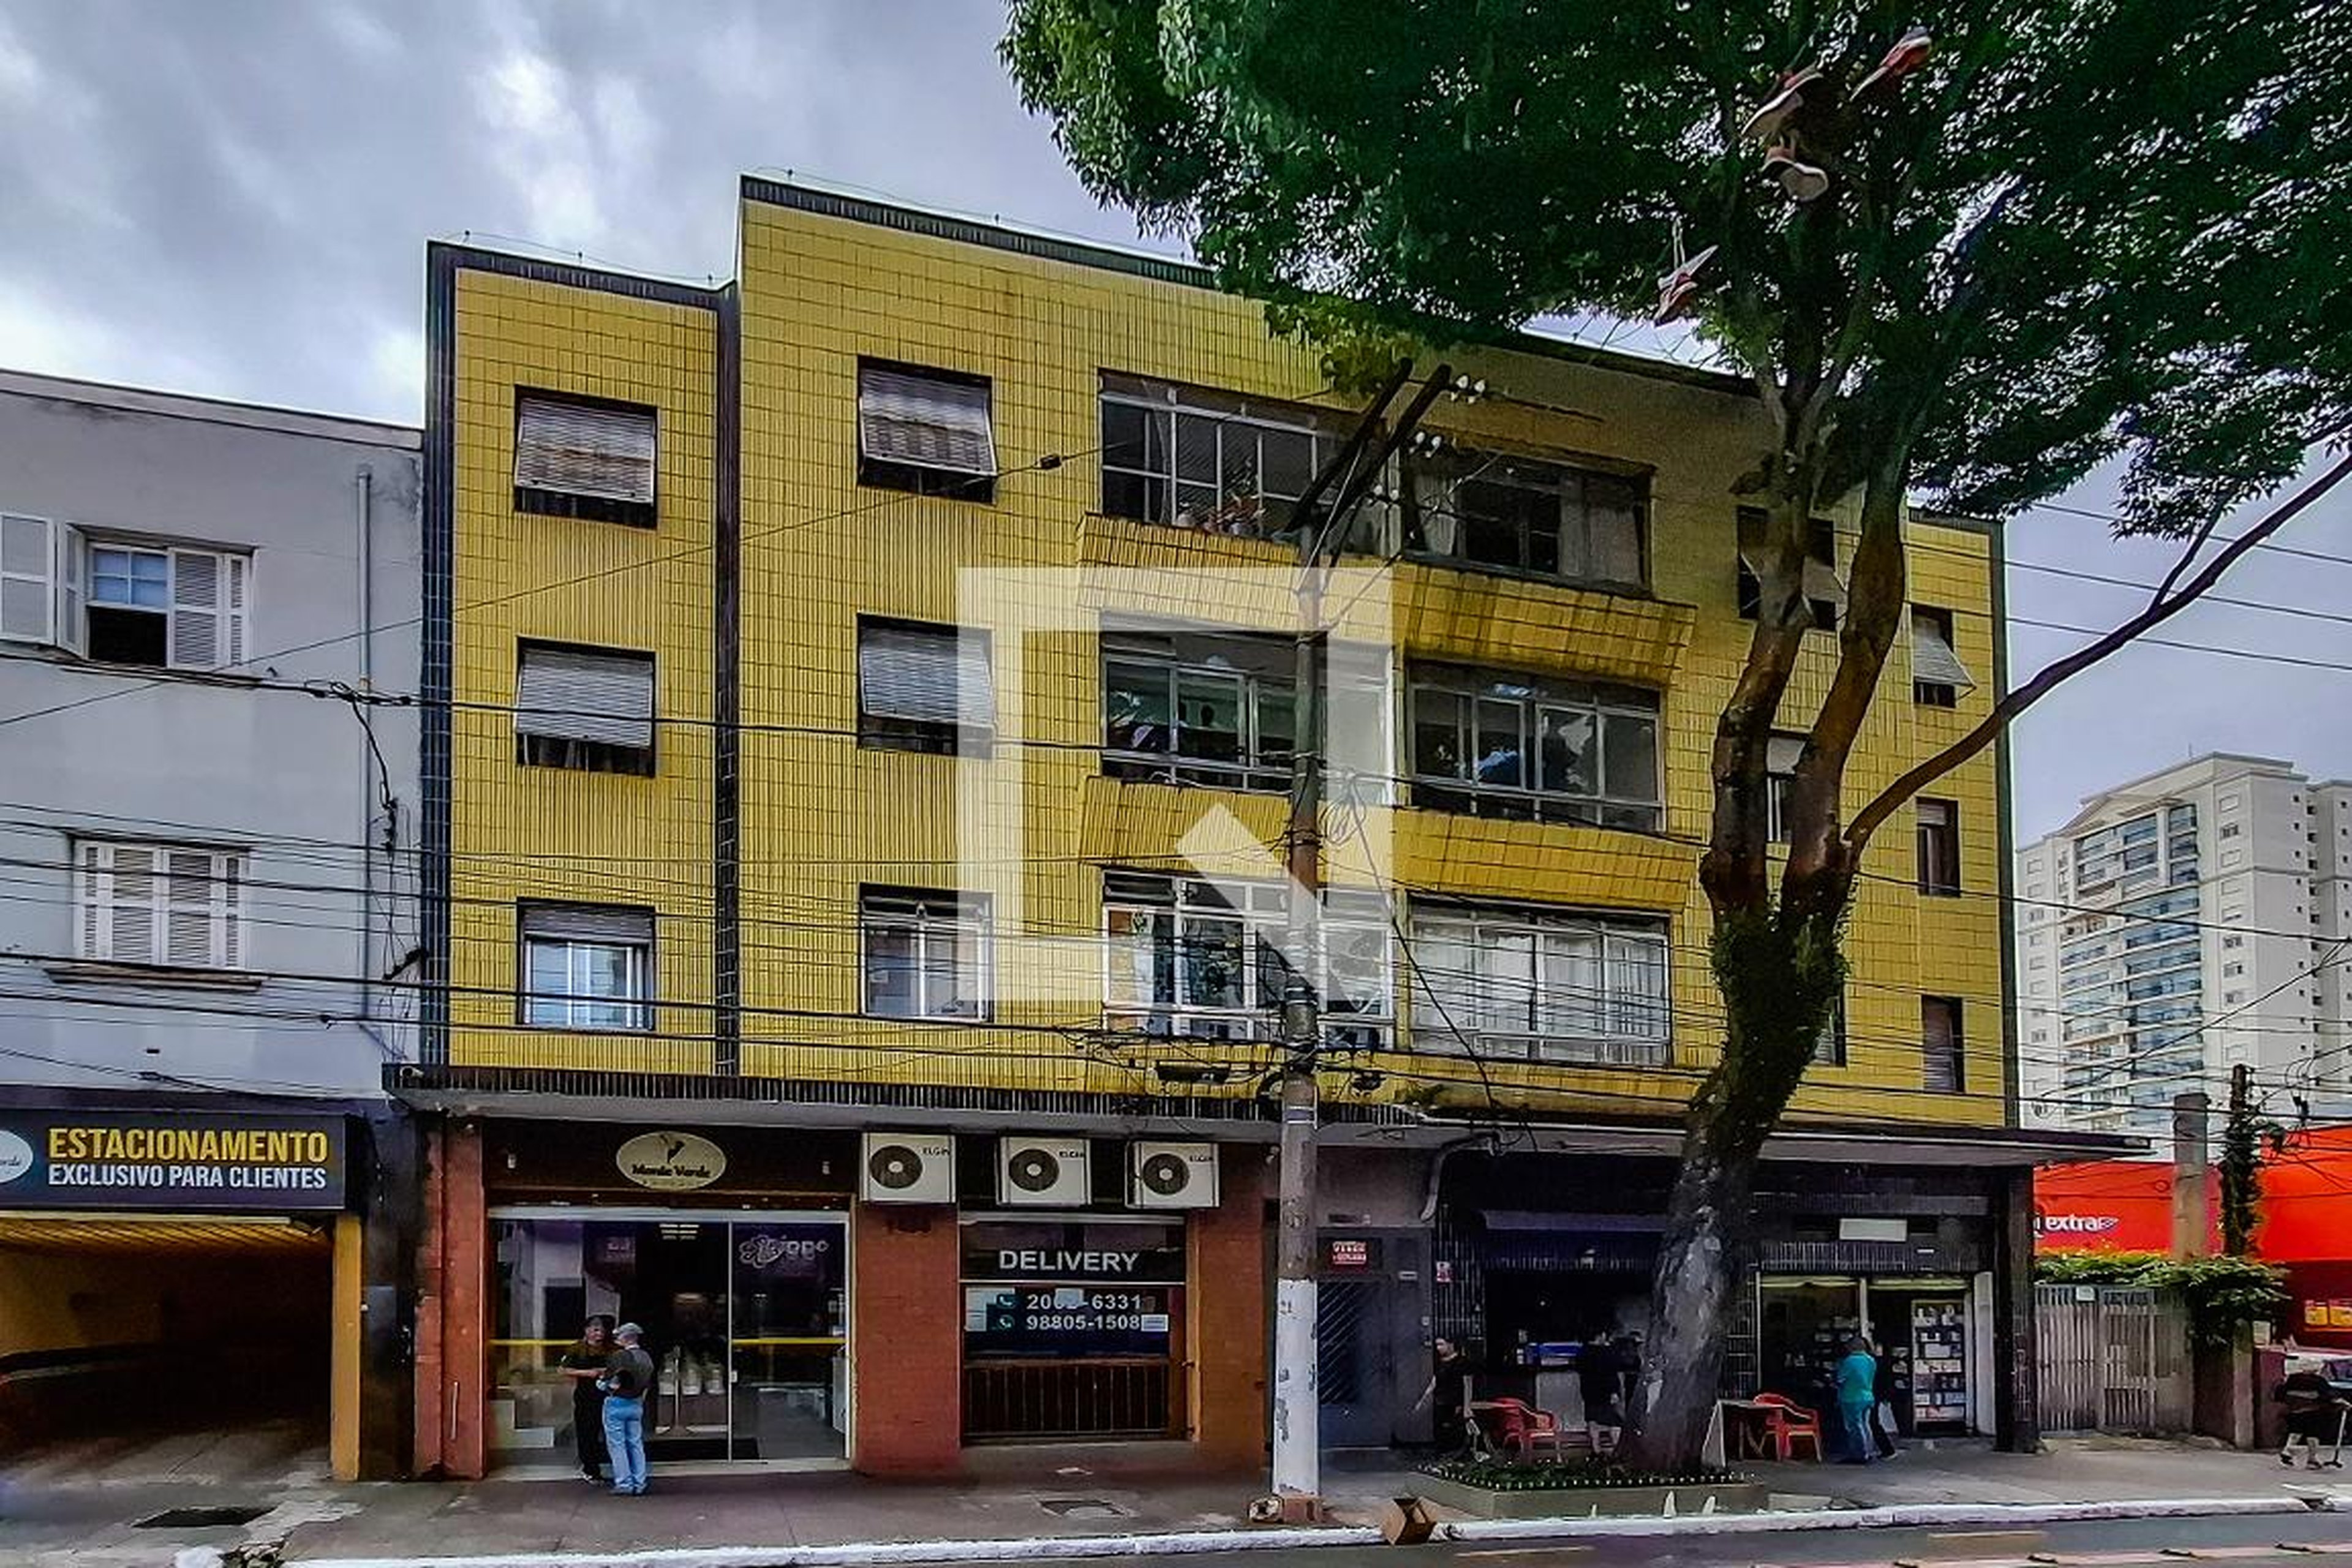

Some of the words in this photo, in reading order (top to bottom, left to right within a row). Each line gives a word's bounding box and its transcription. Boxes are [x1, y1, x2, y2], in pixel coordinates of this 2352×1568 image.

[49, 1128, 328, 1163] ESTACIONAMENTO
[48, 1164, 163, 1186] EXCLUSIVO
[169, 1166, 224, 1187] PARA
[229, 1166, 326, 1188] CLIENTES
[2046, 1214, 2098, 1231] extra
[999, 1250, 1139, 1272] DELIVERY
[1027, 1294, 1140, 1310] 20-6331
[1027, 1314, 1140, 1330] 98805-1508
